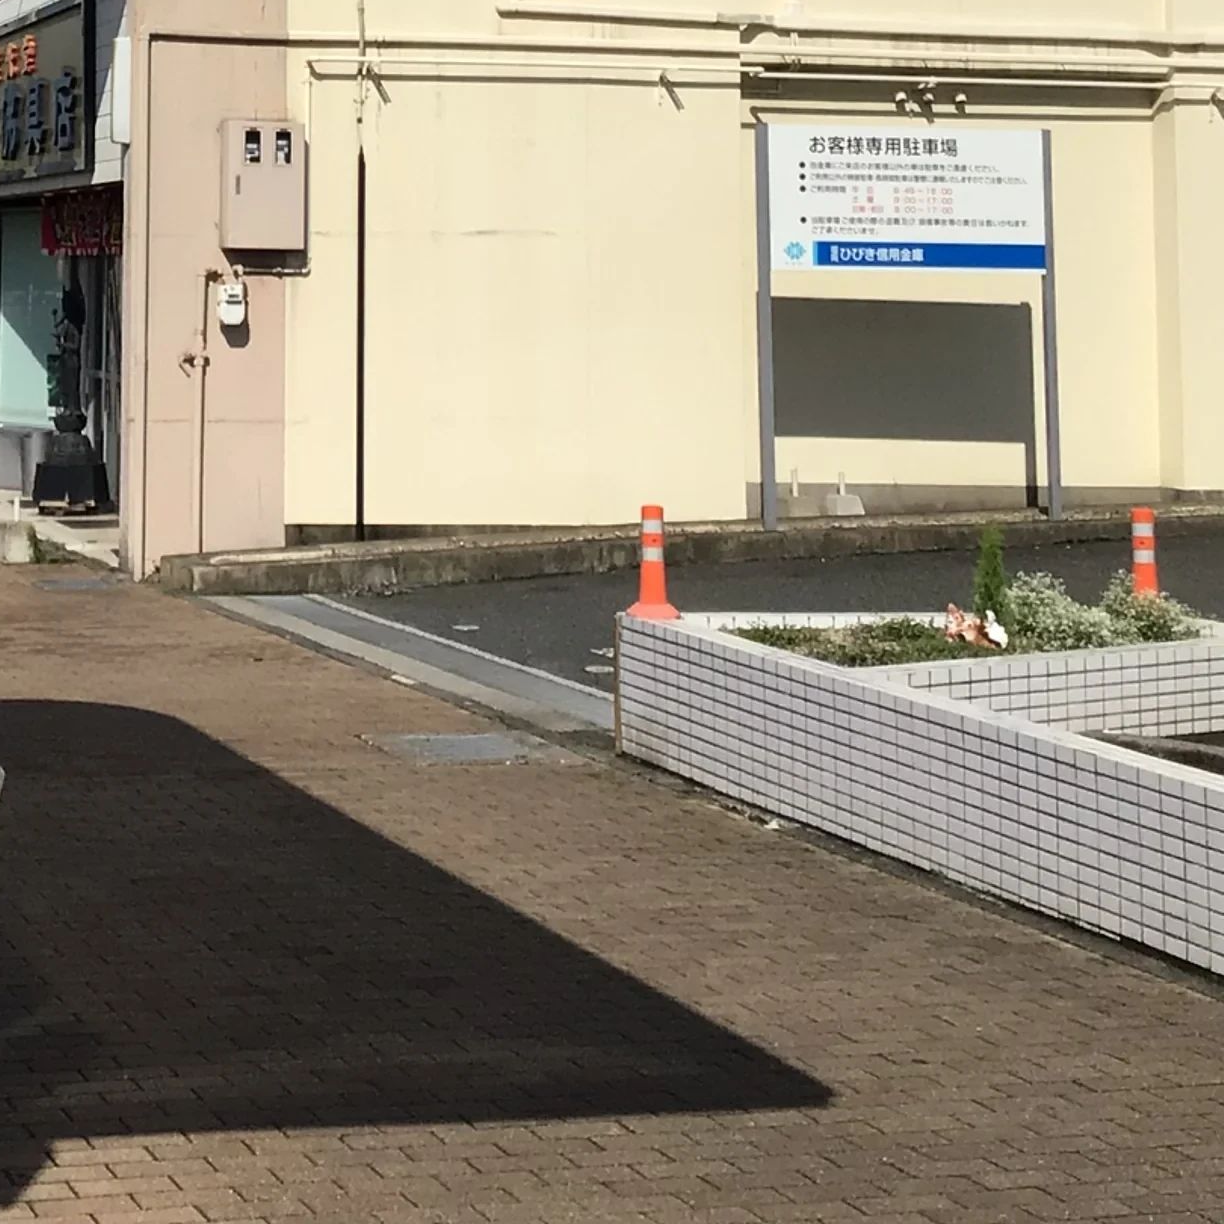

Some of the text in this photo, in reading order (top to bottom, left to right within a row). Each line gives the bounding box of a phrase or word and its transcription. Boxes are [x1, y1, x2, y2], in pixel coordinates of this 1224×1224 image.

[809, 136, 958, 157] お客様専用駐車場
